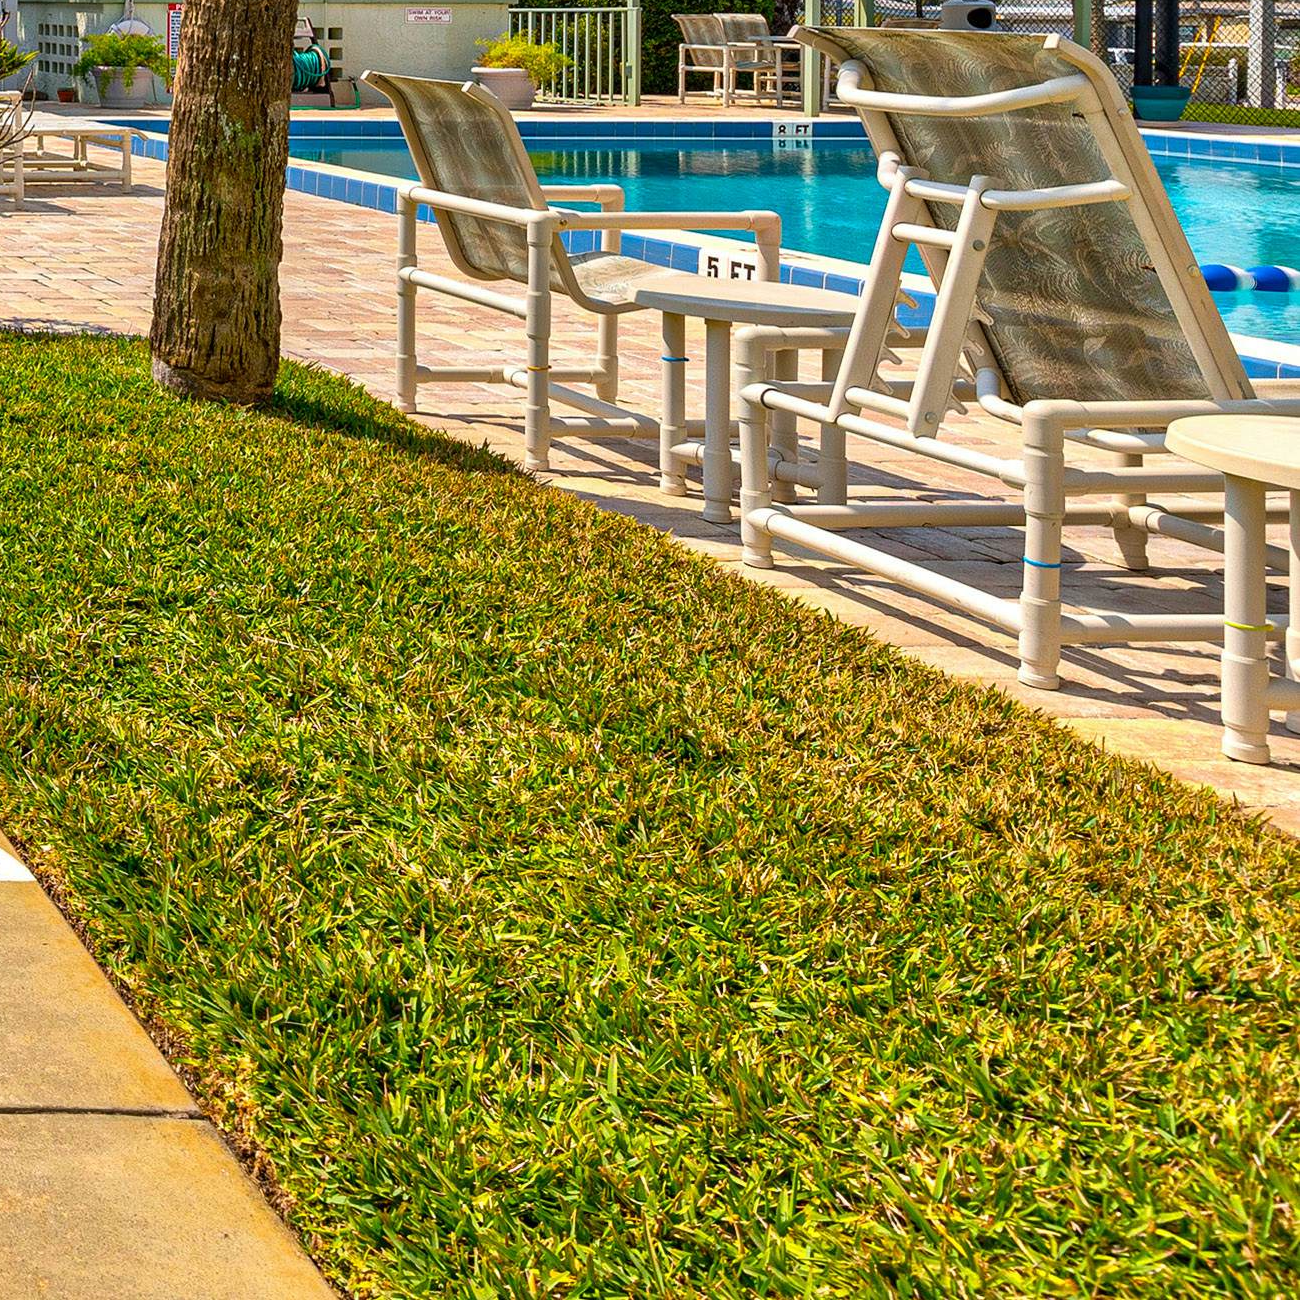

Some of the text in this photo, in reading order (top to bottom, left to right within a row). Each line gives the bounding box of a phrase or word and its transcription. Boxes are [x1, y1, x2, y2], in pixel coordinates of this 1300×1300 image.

[778, 124, 810, 135] 8 FT
[707, 256, 756, 281] 5 FT
